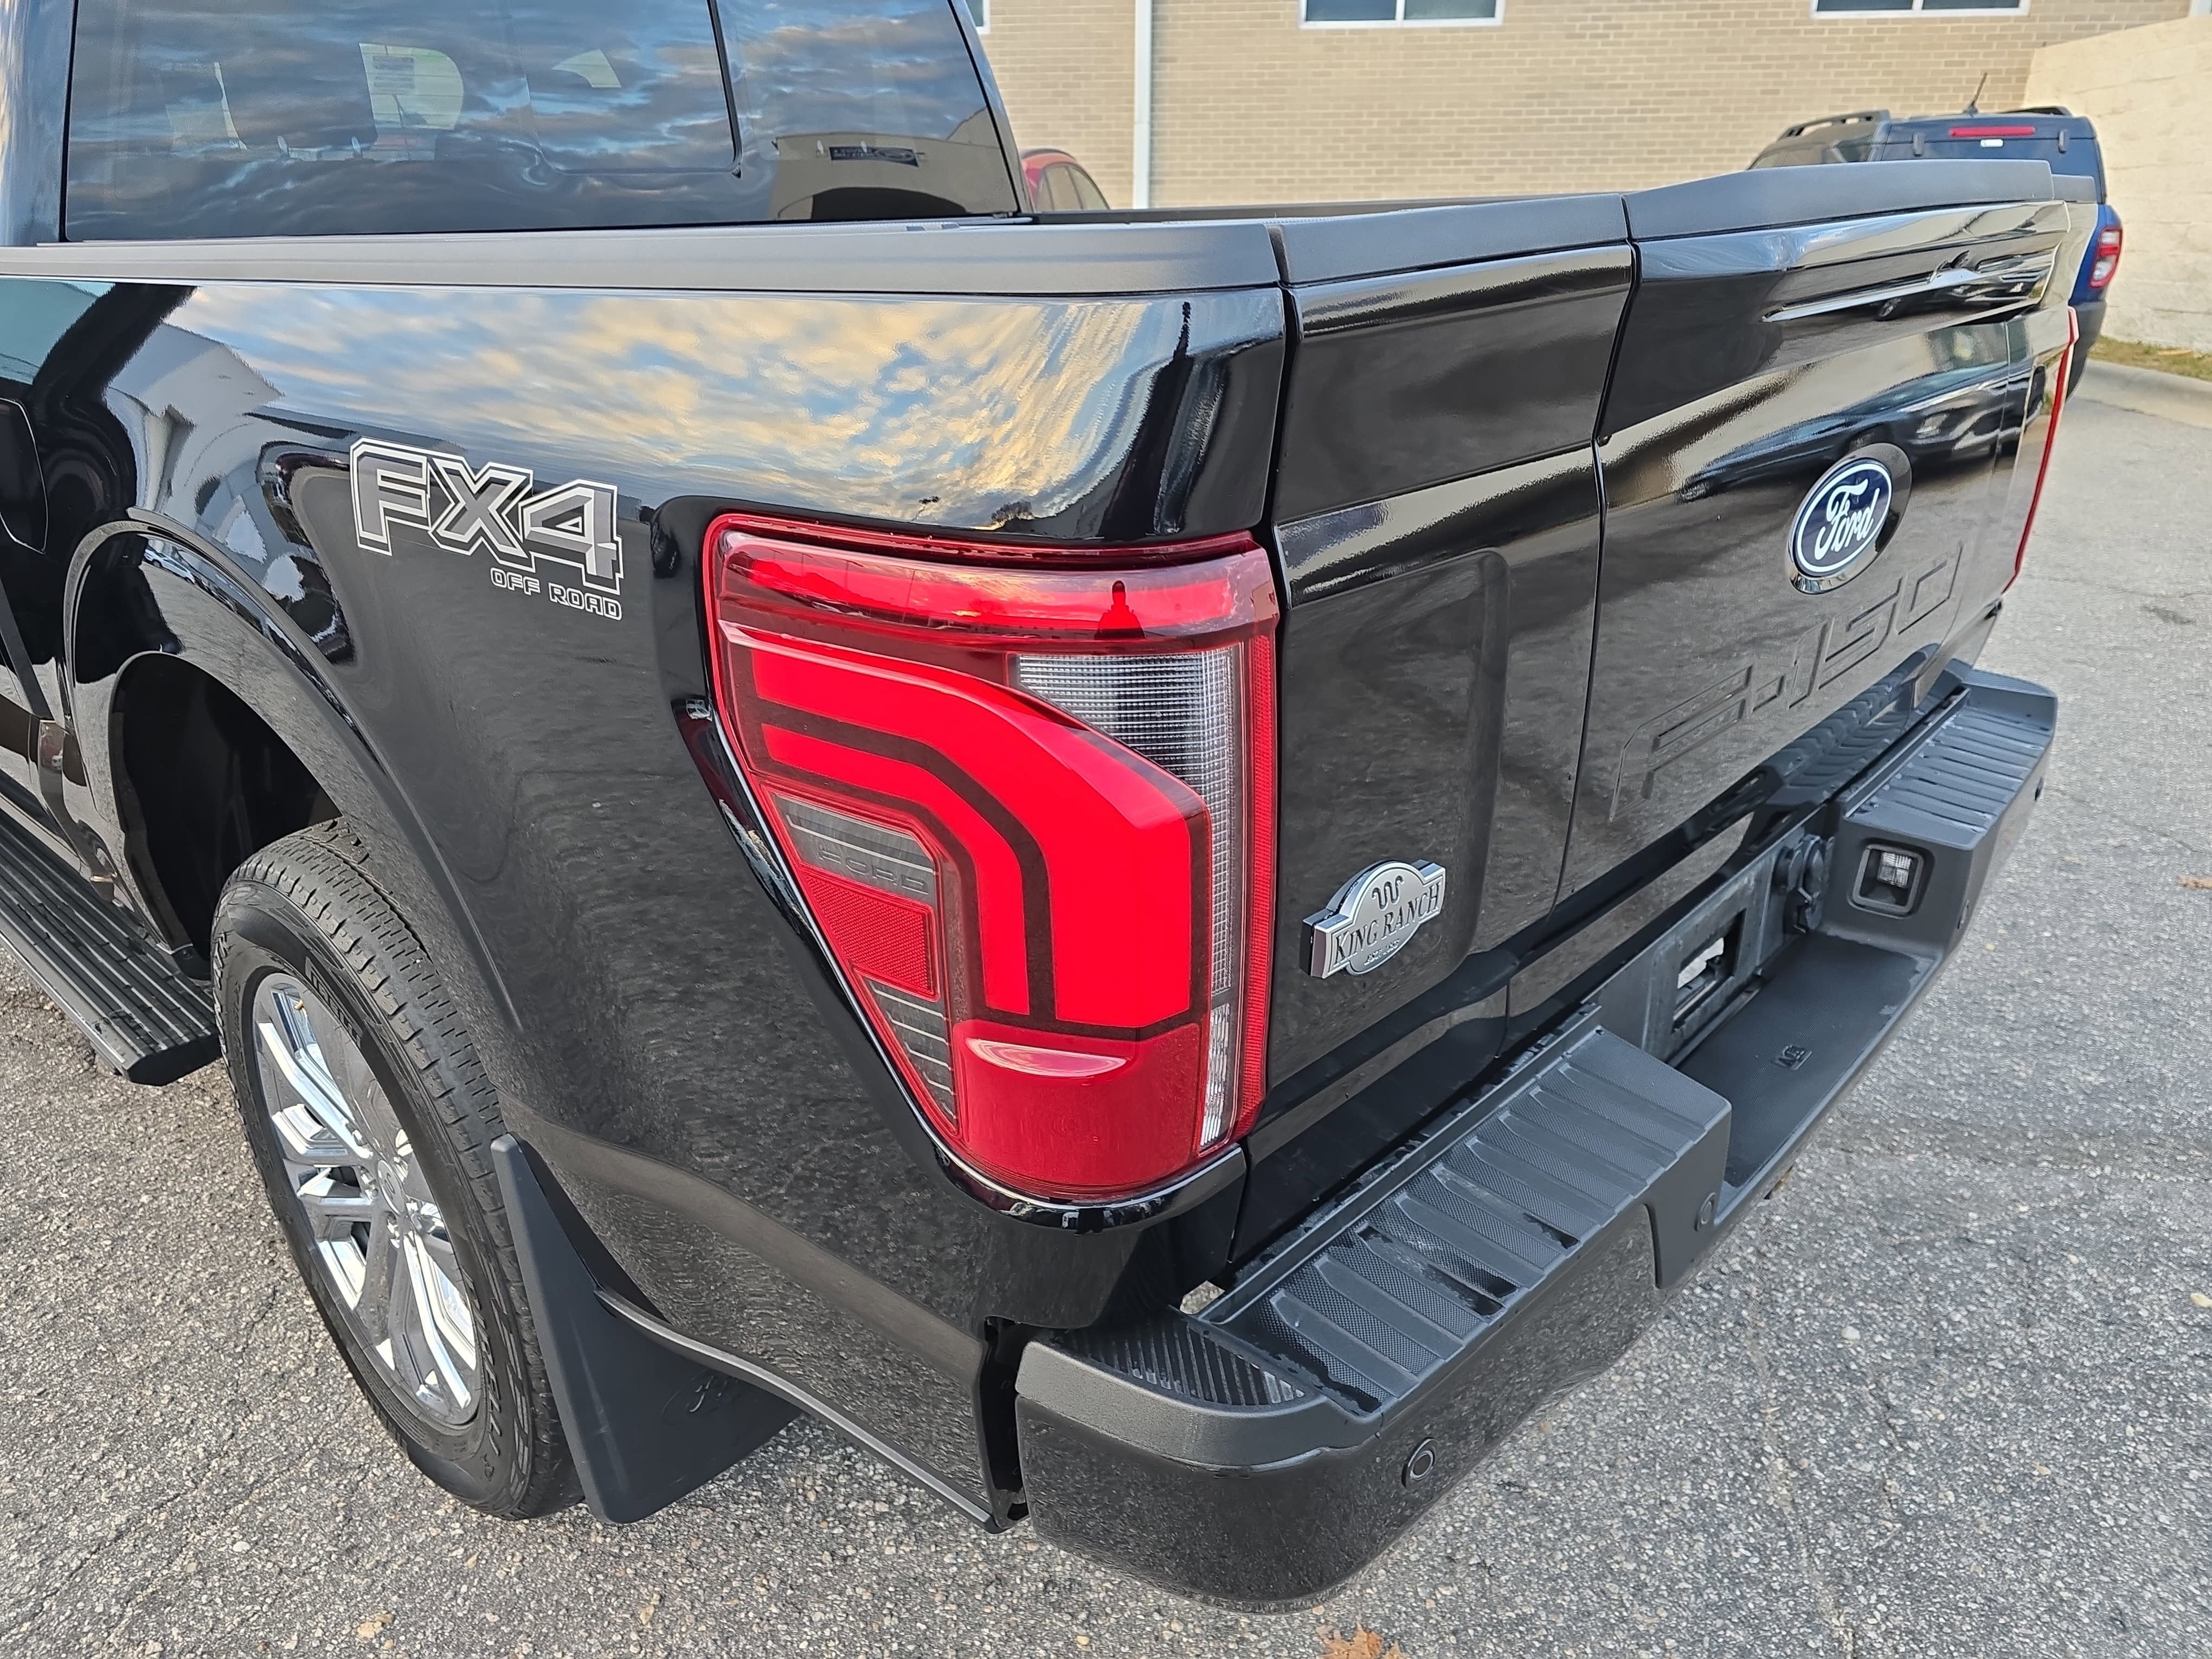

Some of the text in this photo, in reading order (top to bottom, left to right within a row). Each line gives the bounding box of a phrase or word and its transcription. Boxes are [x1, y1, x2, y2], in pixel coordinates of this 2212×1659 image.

[350, 435, 623, 596] FX4
[1814, 478, 1880, 561] Ford
[490, 567, 623, 621] OFF ROAD
[1608, 540, 1964, 822] F-150
[1332, 918, 1380, 968] KING
[1381, 880, 1443, 941] RANCH
